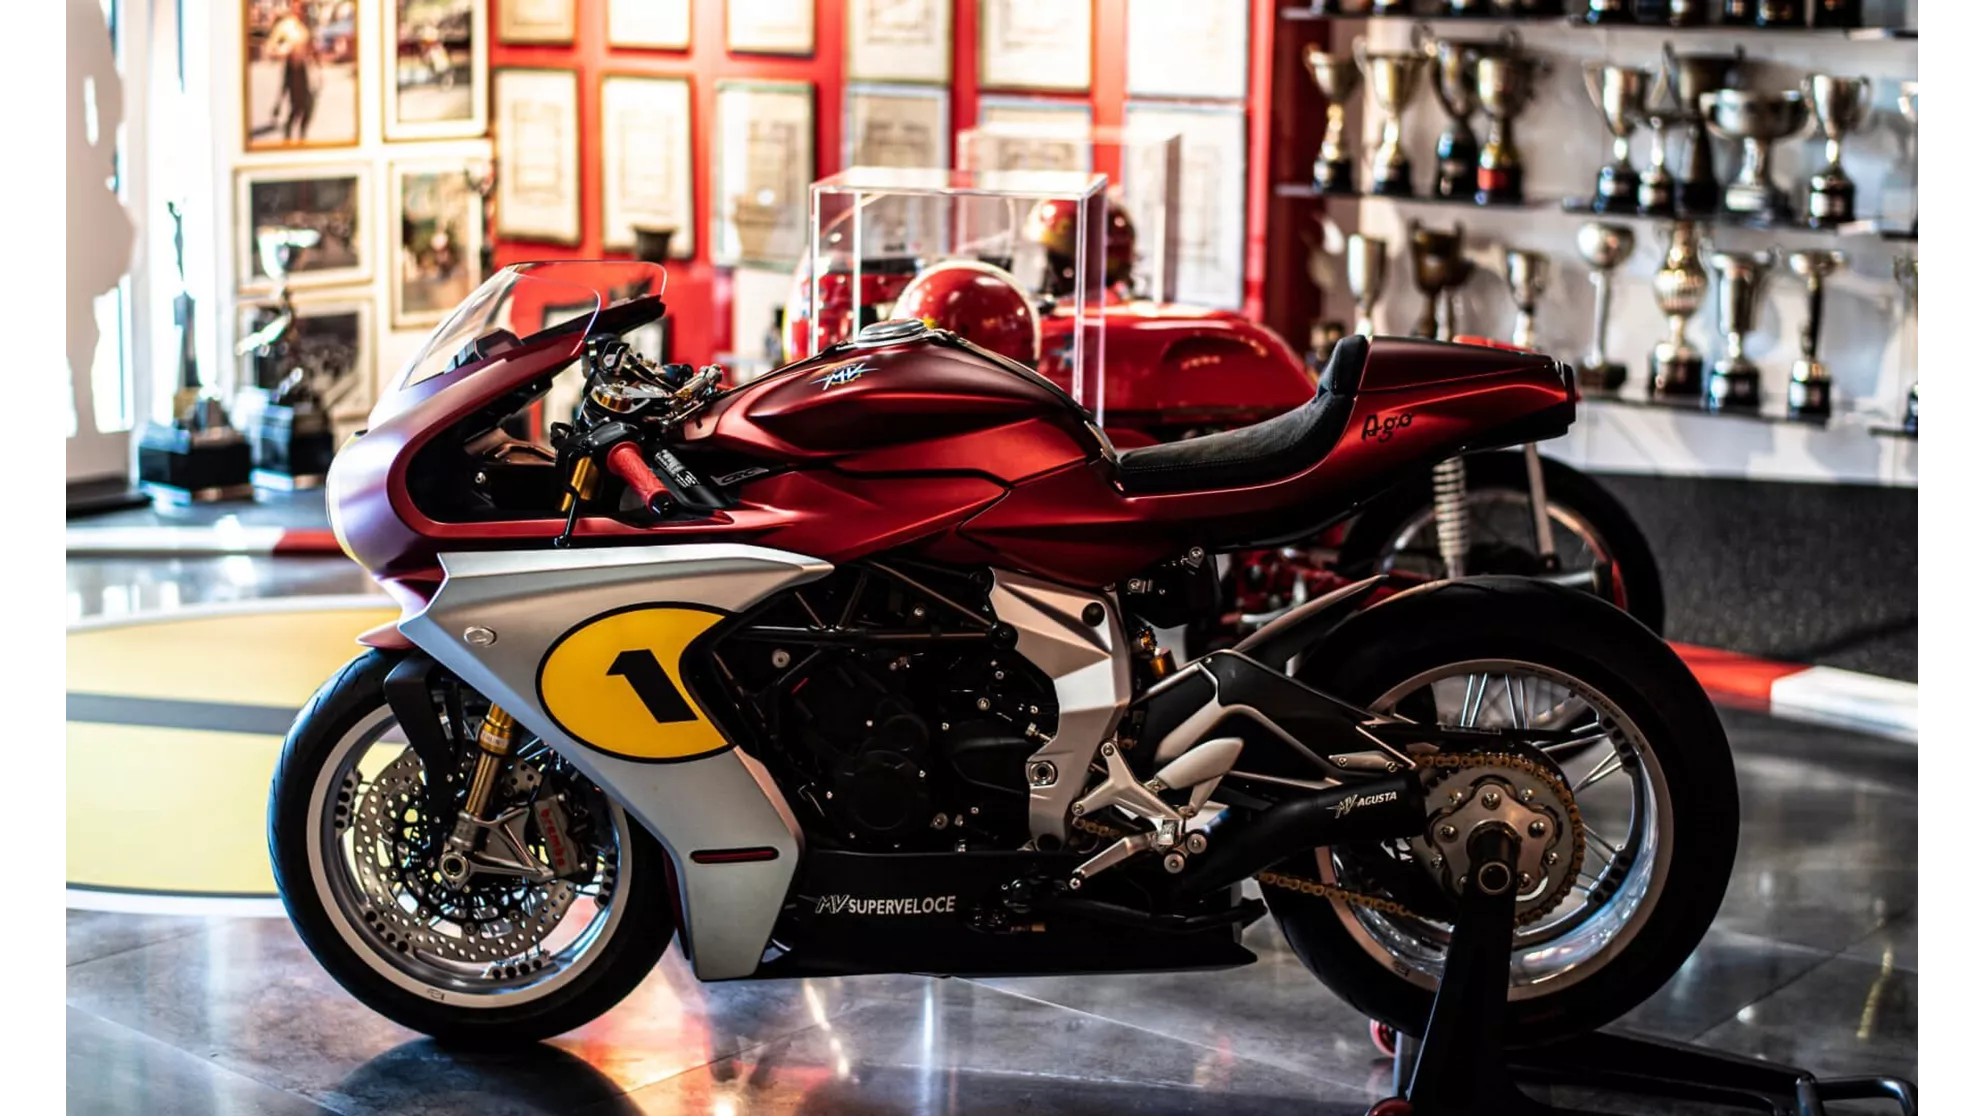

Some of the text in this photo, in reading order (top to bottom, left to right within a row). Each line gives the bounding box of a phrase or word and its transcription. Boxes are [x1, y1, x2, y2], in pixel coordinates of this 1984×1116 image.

[821, 362, 867, 391] MV
[1361, 413, 1412, 443] Ago
[605, 648, 700, 724] 1
[1333, 791, 1397, 819] MV AGUSTA
[540, 808, 567, 869] brembo
[815, 894, 956, 914] MV SUPERVELOCE
